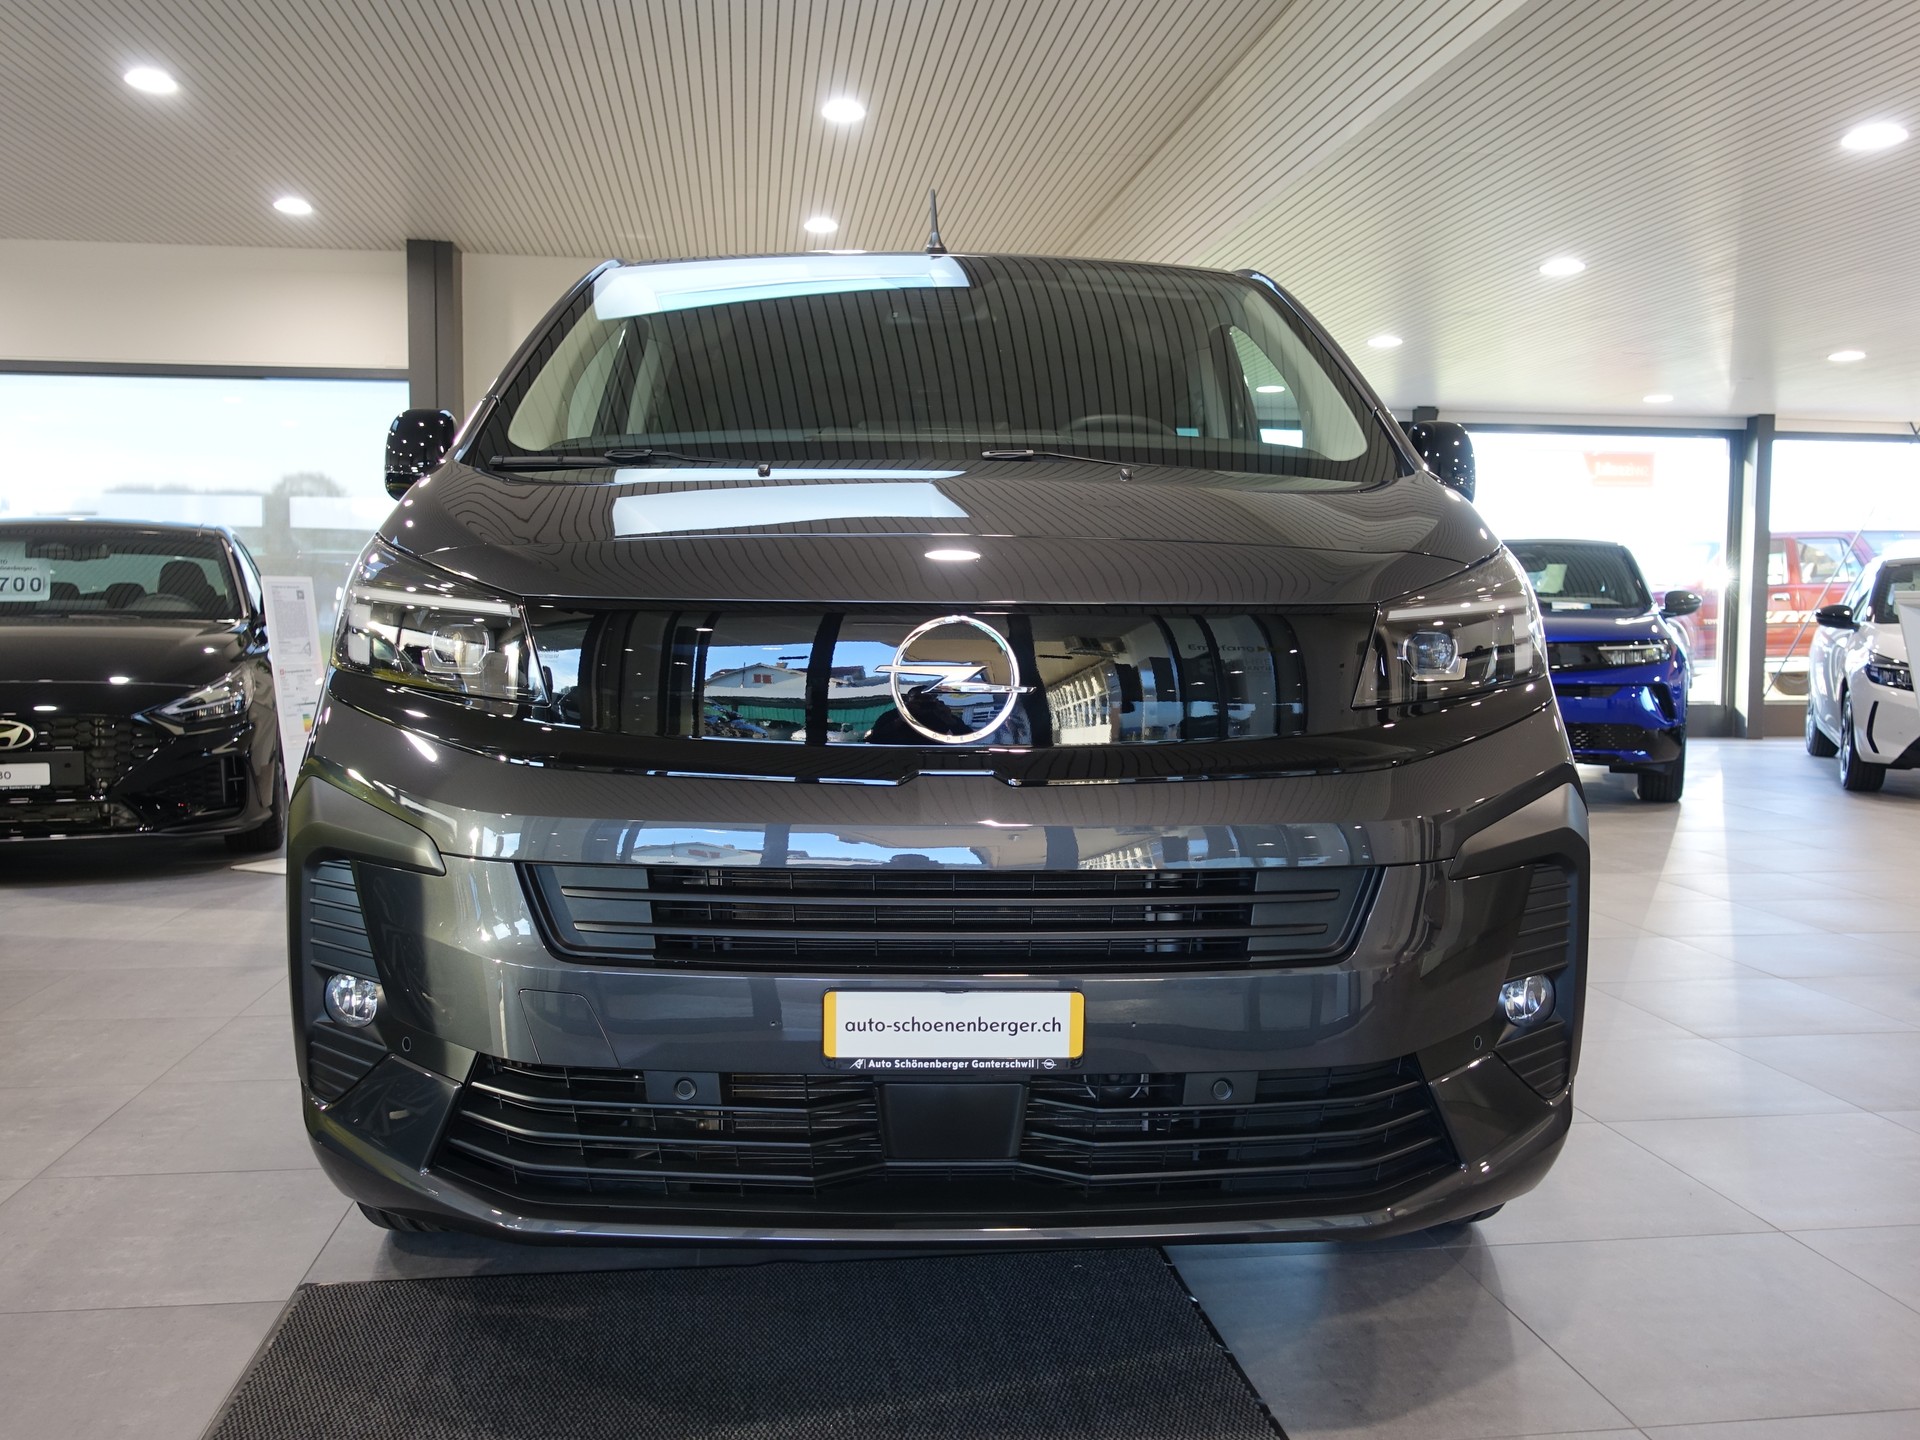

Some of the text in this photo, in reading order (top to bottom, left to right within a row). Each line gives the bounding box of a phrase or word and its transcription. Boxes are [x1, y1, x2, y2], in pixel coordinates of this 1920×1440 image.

[845, 1016, 1062, 1036] auto-schoenenberger.ch
[868, 1059, 1035, 1070] Auto Schönenberger Ganterschwil
